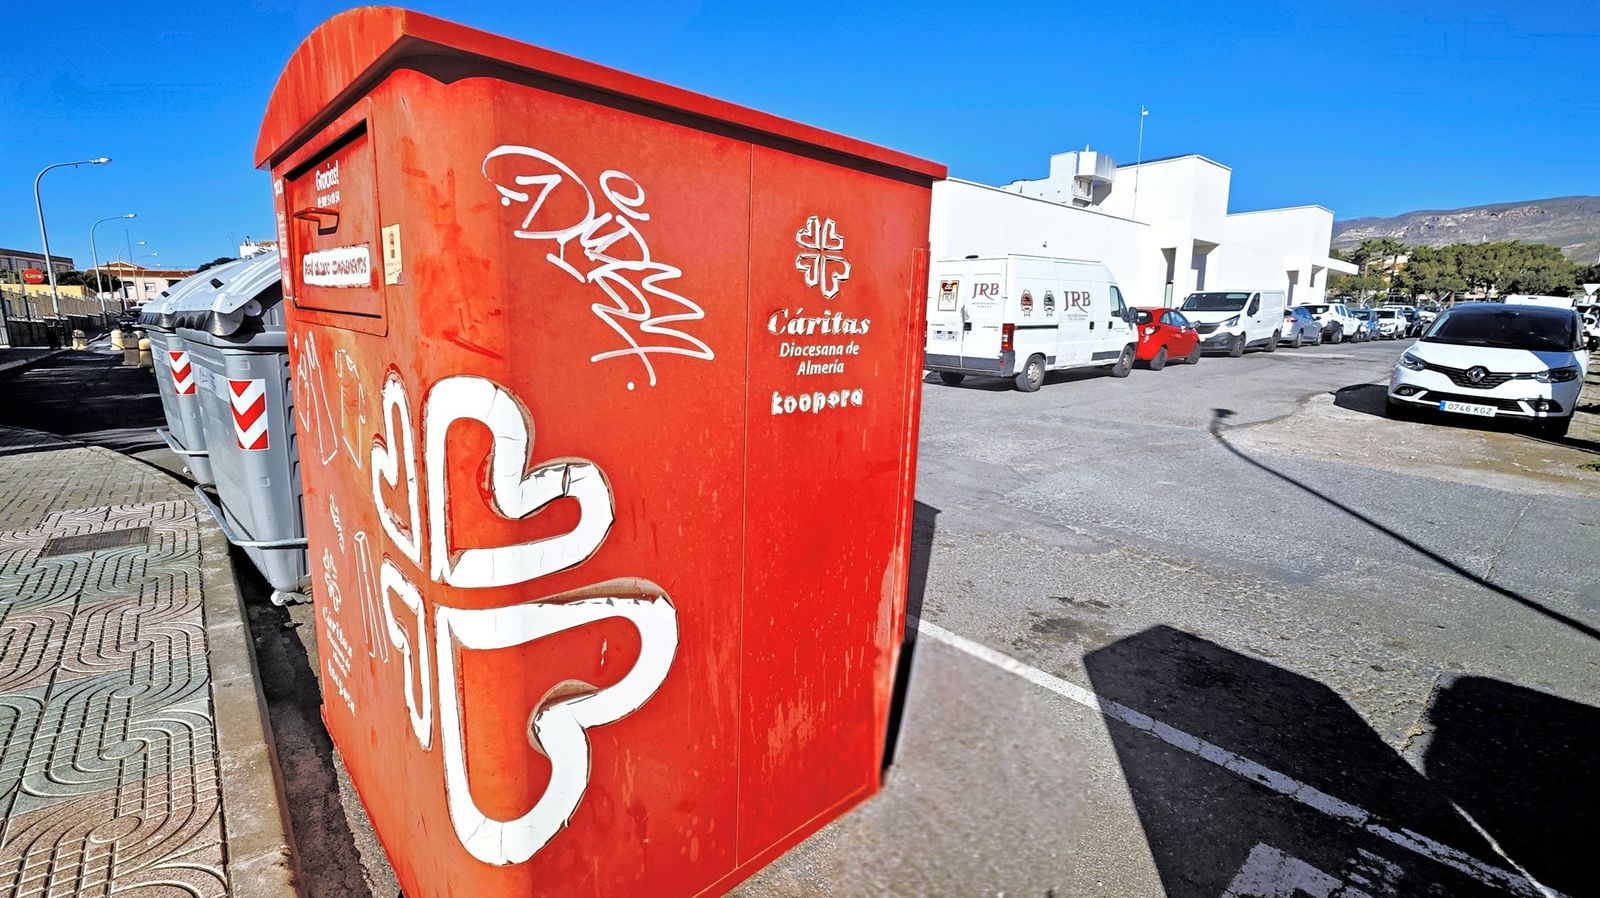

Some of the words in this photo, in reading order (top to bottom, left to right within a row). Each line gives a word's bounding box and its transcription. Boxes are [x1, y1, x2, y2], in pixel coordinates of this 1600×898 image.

[971, 282, 1000, 300] JRB
[1063, 290, 1092, 313] JRB
[767, 307, 871, 336] Cáritas
[779, 342, 845, 357] Diocesana
[845, 341, 860, 356] de
[797, 359, 844, 375] Almería
[771, 388, 863, 415] koopera
[1447, 403, 1471, 412] 0746
[1473, 406, 1492, 415] KGZ
